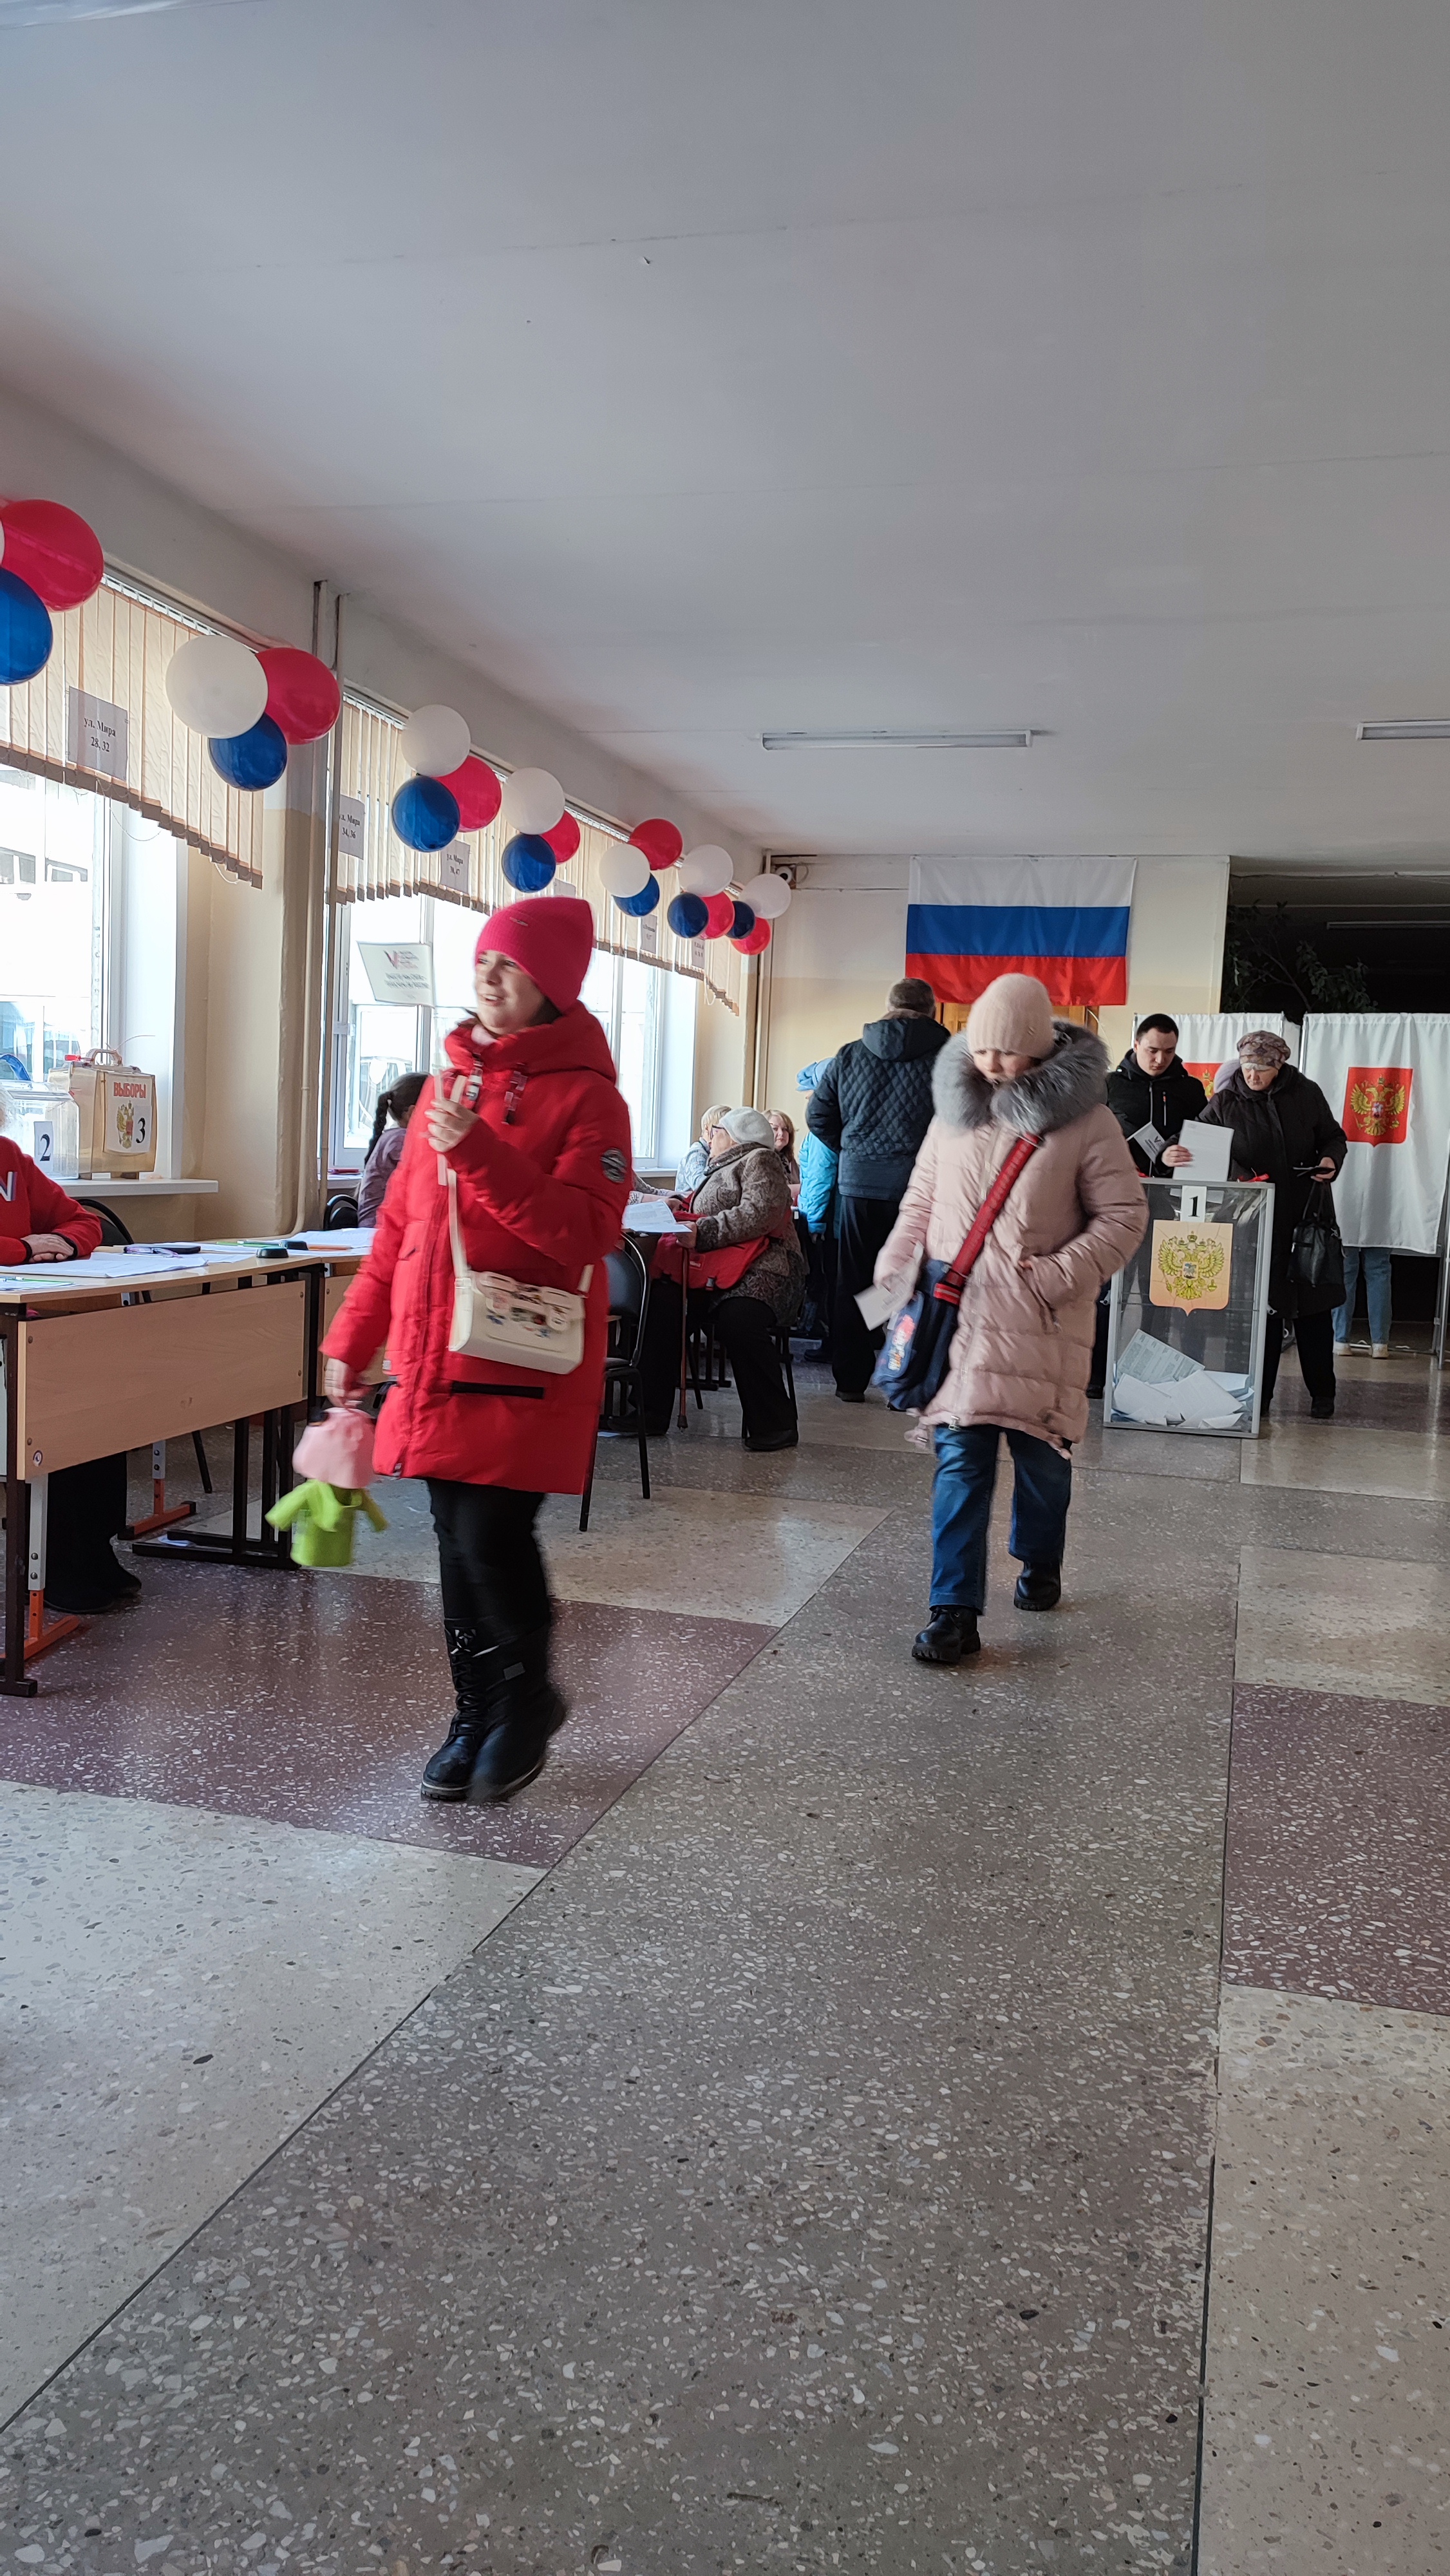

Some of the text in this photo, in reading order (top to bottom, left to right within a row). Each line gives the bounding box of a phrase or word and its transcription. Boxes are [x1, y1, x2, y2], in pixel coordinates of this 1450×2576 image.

[84, 717, 116, 737] ул. Мира
[90, 736, 110, 752] 28, 32
[347, 814, 361, 827] Мира
[113, 1082, 146, 1099] ВЫБОРЫ
[135, 1117, 146, 1144] 3
[40, 1133, 52, 1162] 2
[1188, 1196, 1200, 1218] 1
